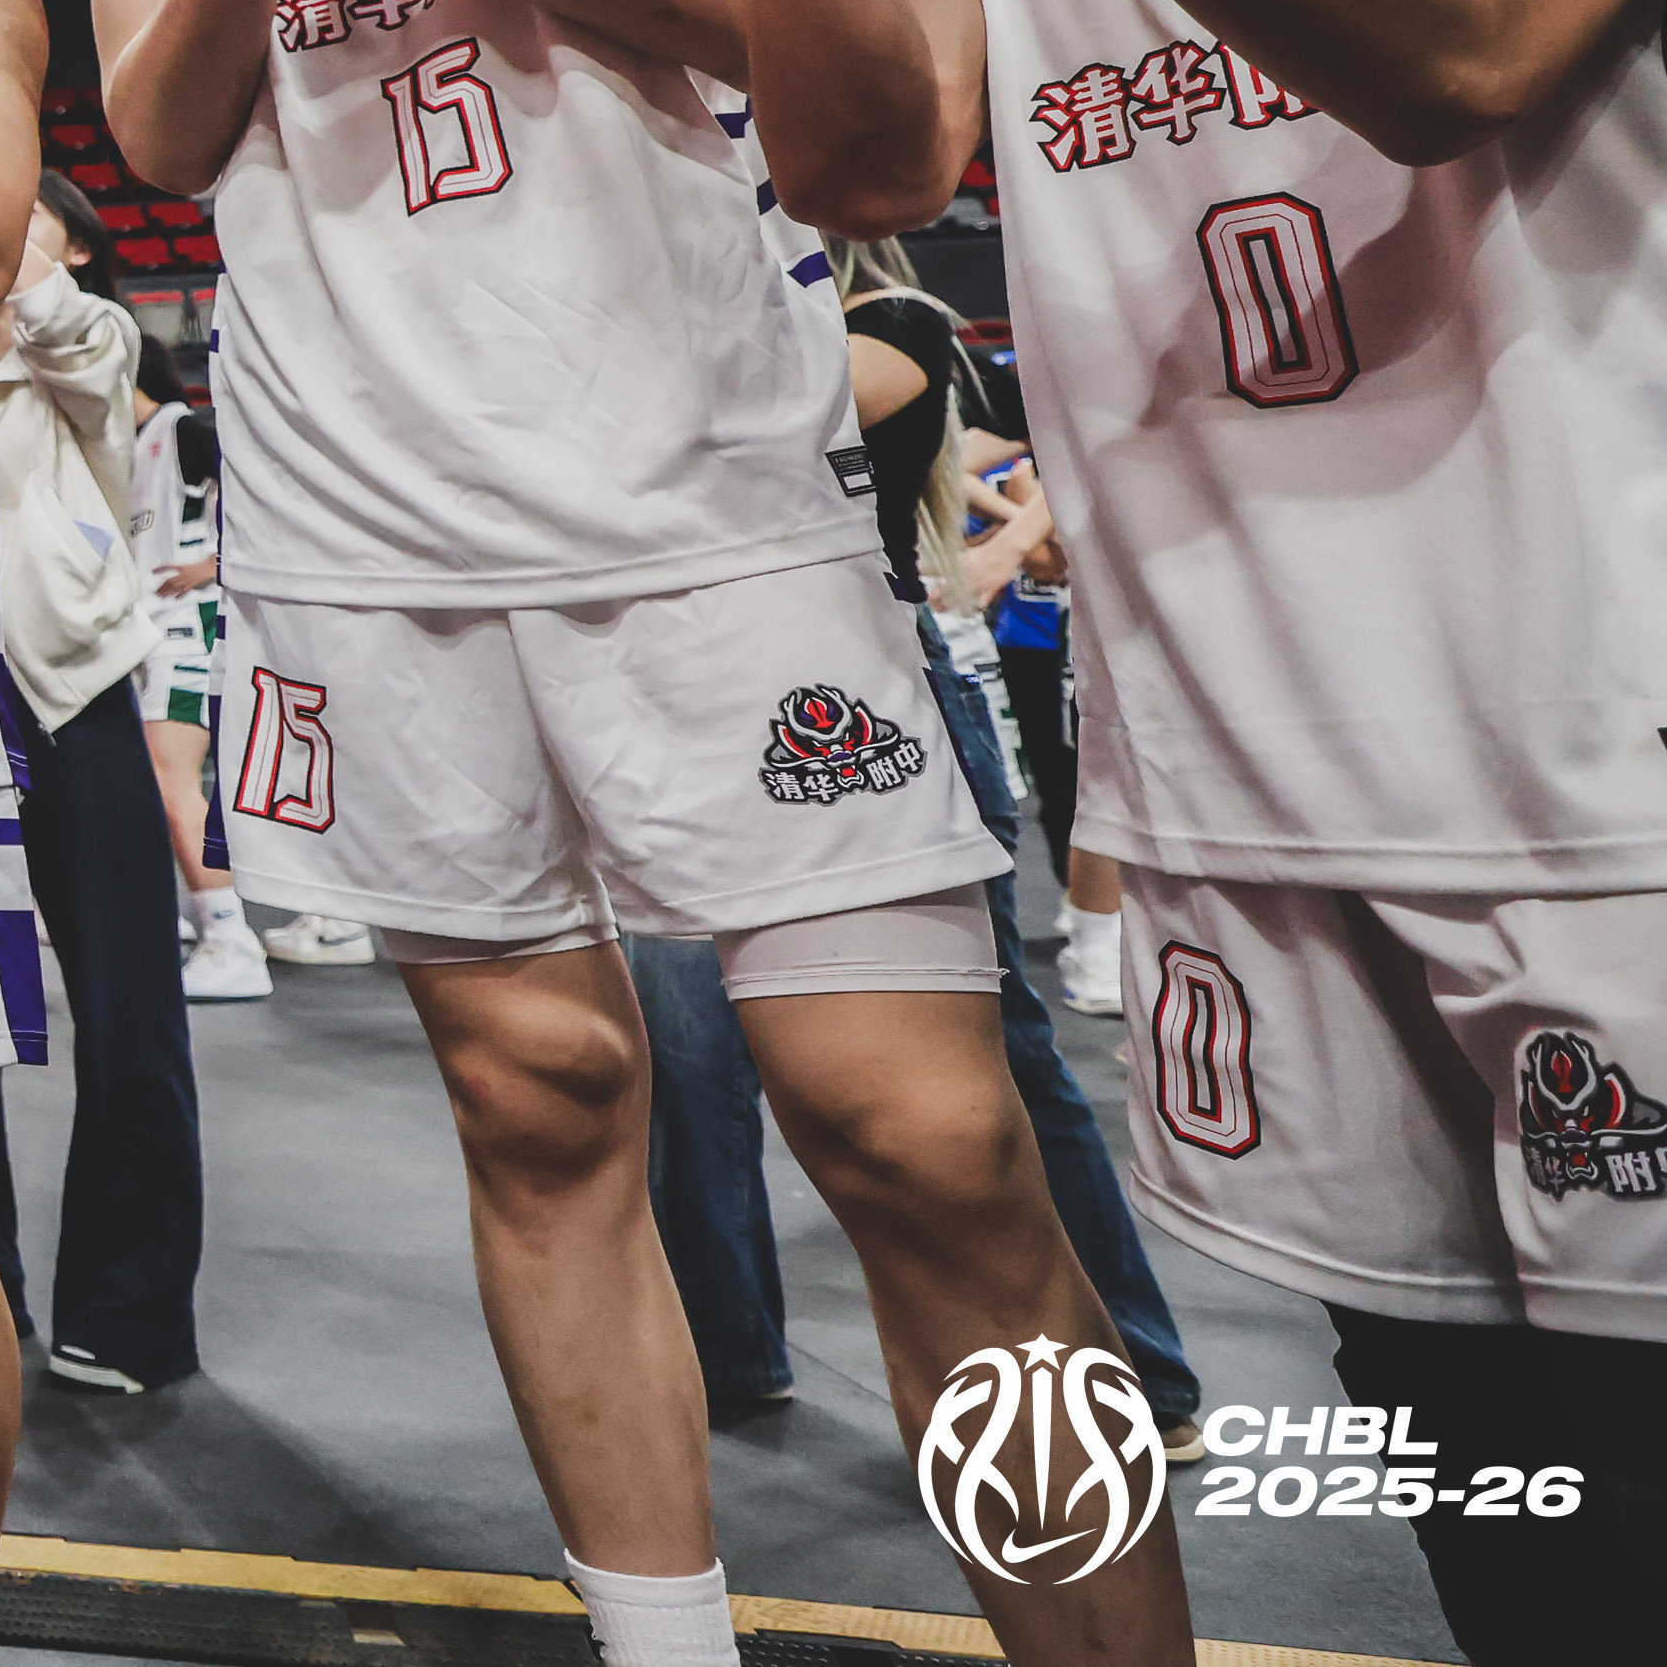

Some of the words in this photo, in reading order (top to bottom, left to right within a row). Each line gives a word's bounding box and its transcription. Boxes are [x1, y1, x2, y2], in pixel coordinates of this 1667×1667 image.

[380, 36, 514, 217] 15
[1195, 191, 1360, 410] 0
[233, 665, 334, 835] 15
[765, 741, 921, 802] 清华附中
[1152, 939, 1261, 1160] 0
